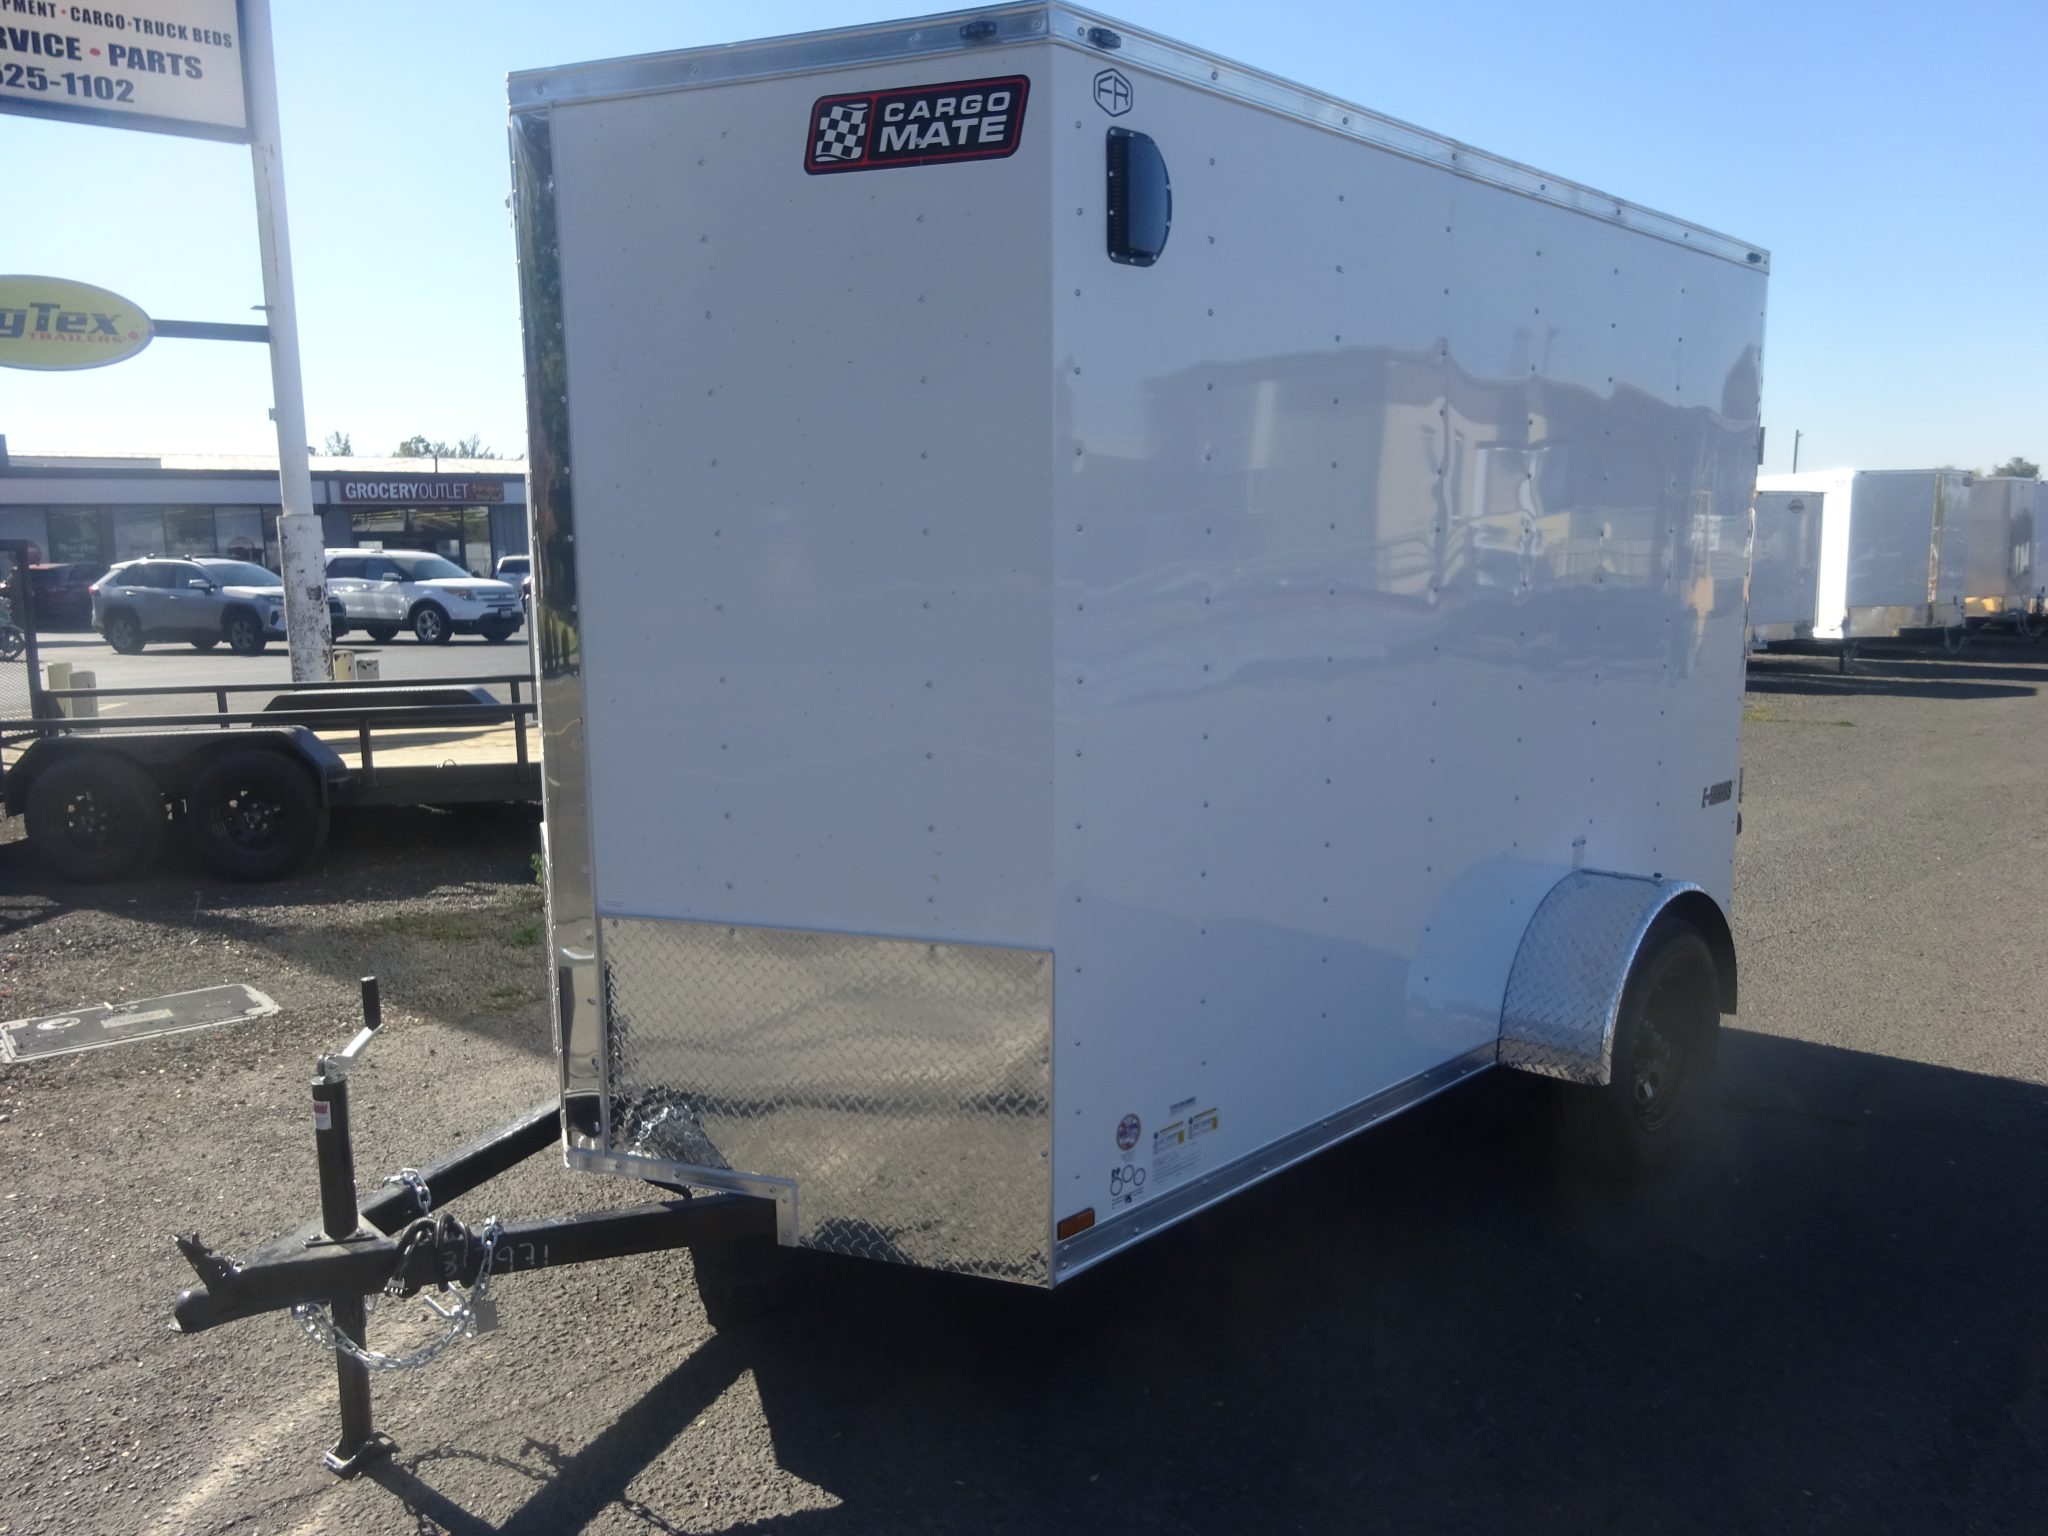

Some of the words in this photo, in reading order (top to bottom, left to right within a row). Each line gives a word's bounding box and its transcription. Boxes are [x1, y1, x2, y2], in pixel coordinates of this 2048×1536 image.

[71, 7, 125, 30] CARGO
[132, 17, 188, 41] TRUCK
[193, 27, 233, 48] BEDS
[108, 43, 203, 80] PARTS
[0, 63, 135, 103] 25-1102
[884, 91, 1010, 122] CARGO
[879, 114, 1008, 152] MATE
